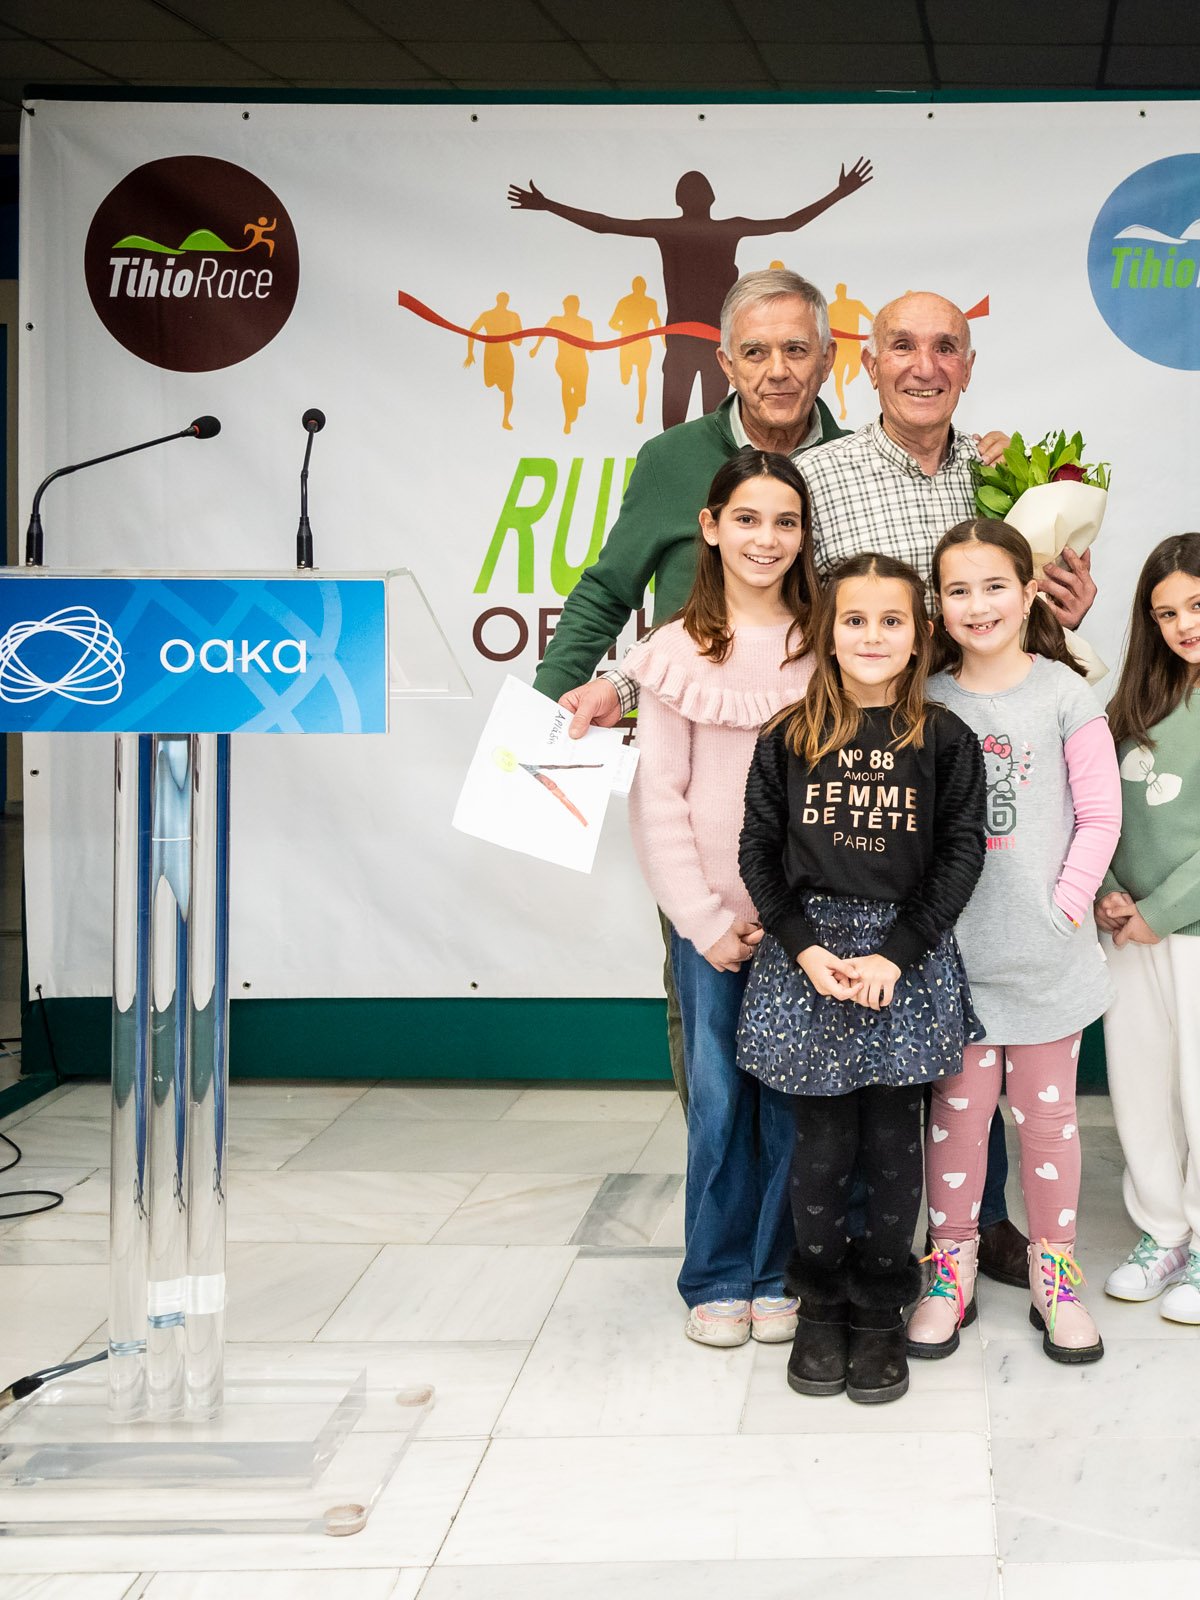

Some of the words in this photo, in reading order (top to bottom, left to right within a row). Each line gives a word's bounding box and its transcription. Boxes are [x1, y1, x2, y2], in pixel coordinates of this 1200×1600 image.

[109, 257, 273, 299] TihioRace
[869, 749, 894, 770] 88
[843, 770, 885, 781] AMOUR
[805, 781, 918, 810] FEMME
[802, 806, 836, 825] DE
[849, 807, 918, 832] TÊTE
[833, 831, 886, 852] PARIS
